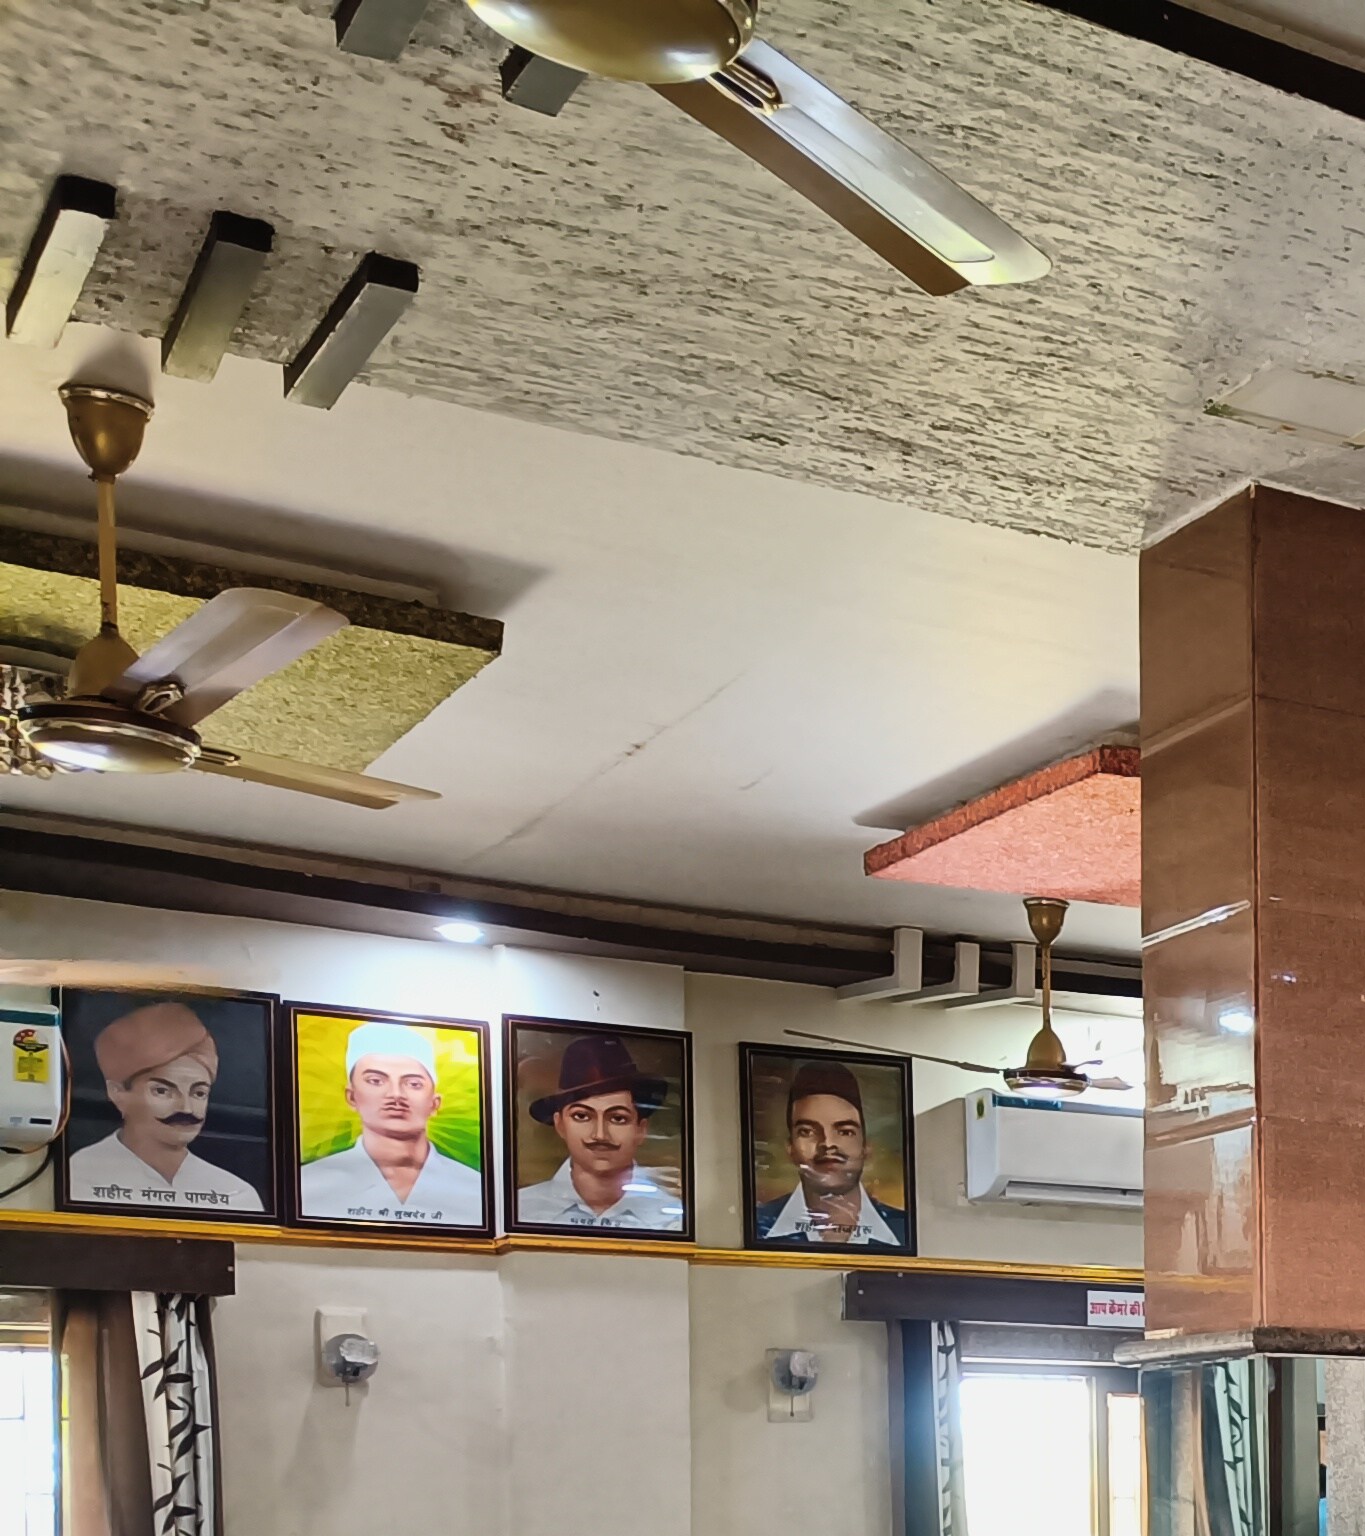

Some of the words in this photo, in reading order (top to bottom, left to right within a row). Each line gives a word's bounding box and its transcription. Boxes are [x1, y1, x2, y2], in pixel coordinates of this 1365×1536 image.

[93, 1184, 133, 1199] शहीद
[141, 1187, 176, 1202] मंगल
[185, 1189, 230, 1205] पाण्डेय
[1090, 1302, 1107, 1314] आप
[1130, 1301, 1140, 1316] की
